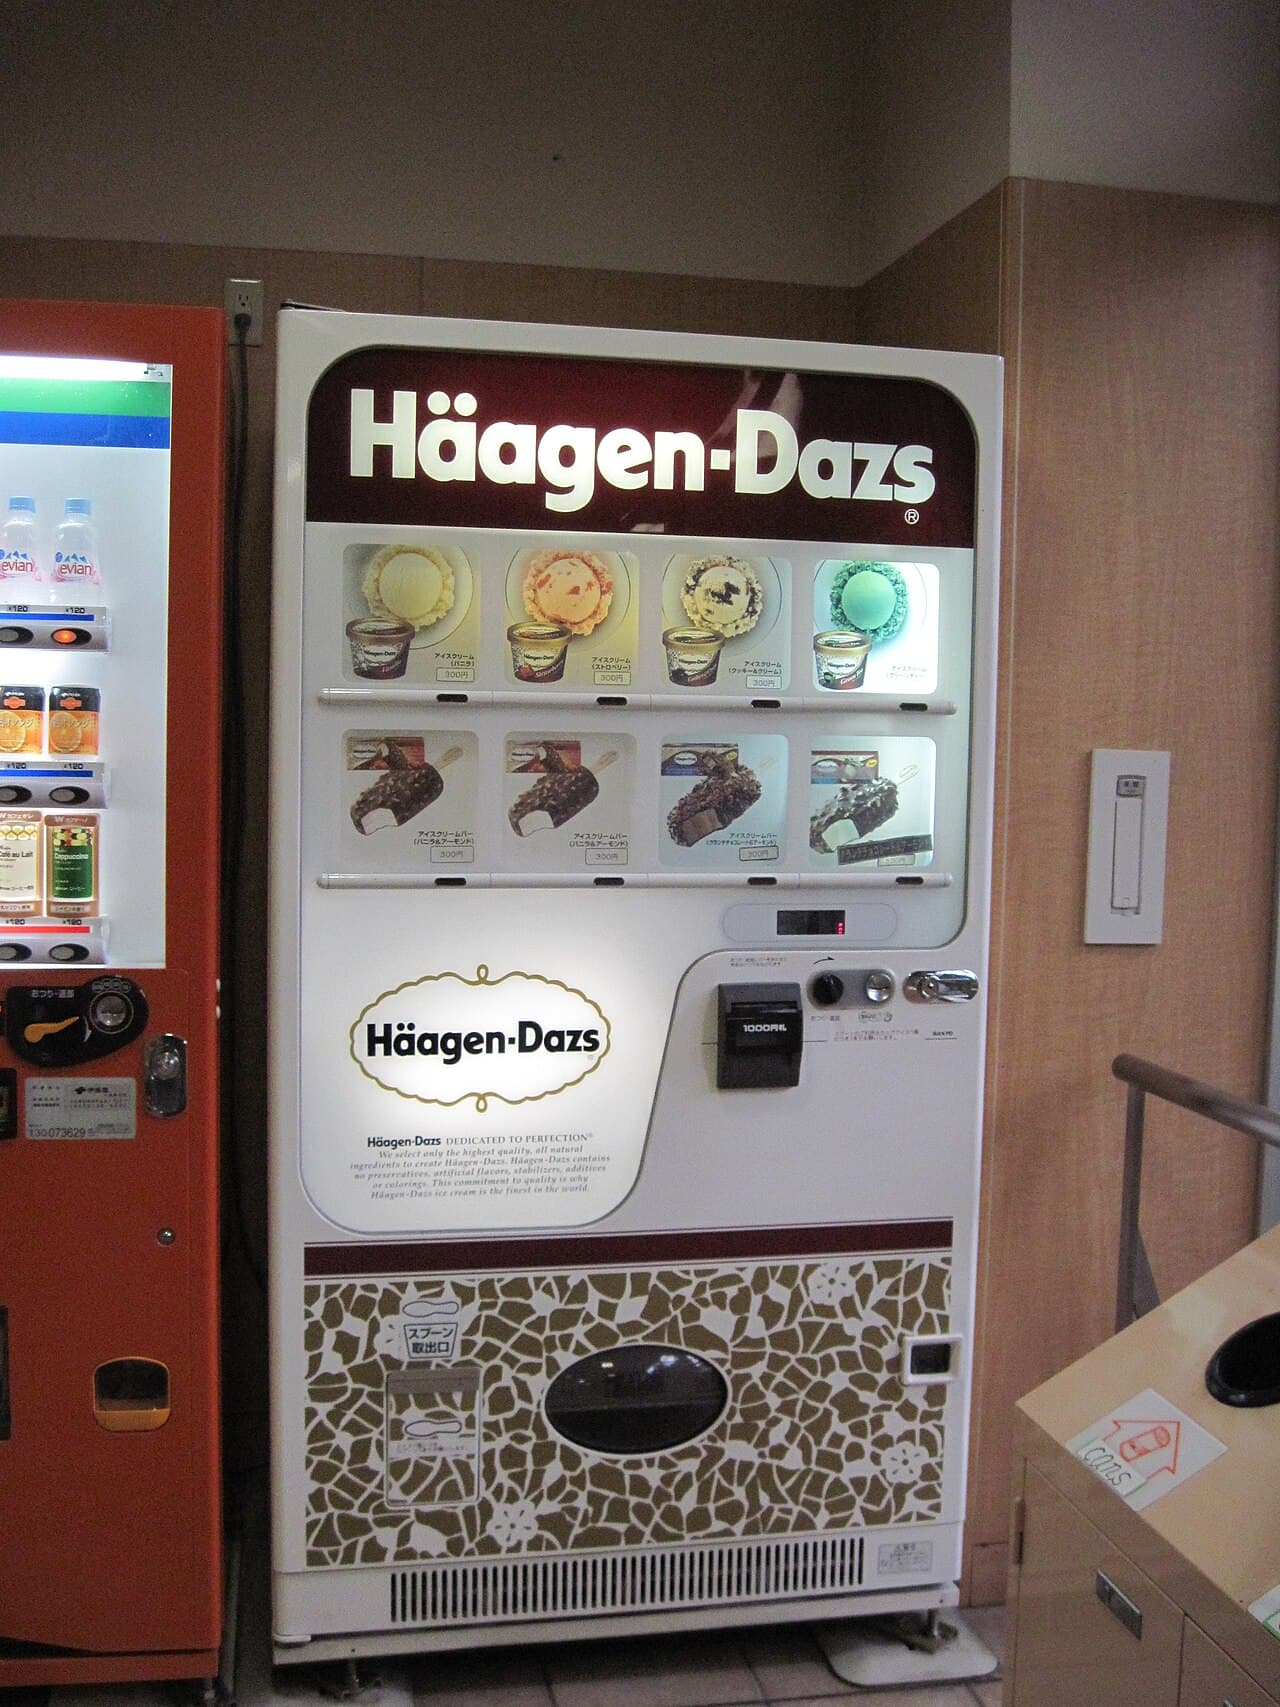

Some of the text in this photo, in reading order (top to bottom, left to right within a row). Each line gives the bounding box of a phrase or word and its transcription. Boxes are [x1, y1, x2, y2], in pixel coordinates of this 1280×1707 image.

[349, 387, 936, 513] Häagen-Dazs
[2, 560, 33, 572] evian
[60, 562, 92, 576] evian
[434, 652, 474, 660] アイスクリーム
[591, 656, 631, 664] アイスクリーム
[417, 830, 474, 838] アイスクリームバー
[573, 832, 629, 840] アイスクリームバー
[366, 1020, 600, 1065] Häagen-Dazs
[367, 1135, 441, 1150] Häagen-Dazs
[446, 1136, 506, 1145] DEDICATED
[509, 1135, 523, 1144] TO
[395, 1149, 421, 1159] select
[423, 1149, 443, 1159] only
[447, 1148, 460, 1157] the
[463, 1147, 495, 1159] highest
[536, 1145, 549, 1154] all
[550, 1144, 583, 1154] natural
[350, 1161, 400, 1172] ingredients
[415, 1159, 442, 1169] create
[573, 1154, 610, 1163] contains
[433, 1167, 474, 1178] artificial
[565, 1164, 606, 1173] additives
[433, 1178, 452, 1188] This
[454, 1176, 509, 1187] commitment
[524, 1174, 557, 1186] quality
[569, 1173, 589, 1184] why
[449, 1188, 477, 1197] cream
[506, 1184, 531, 1196] finest
[408, 1327, 454, 1340] スプーン
[411, 1341, 450, 1354] 取出口
